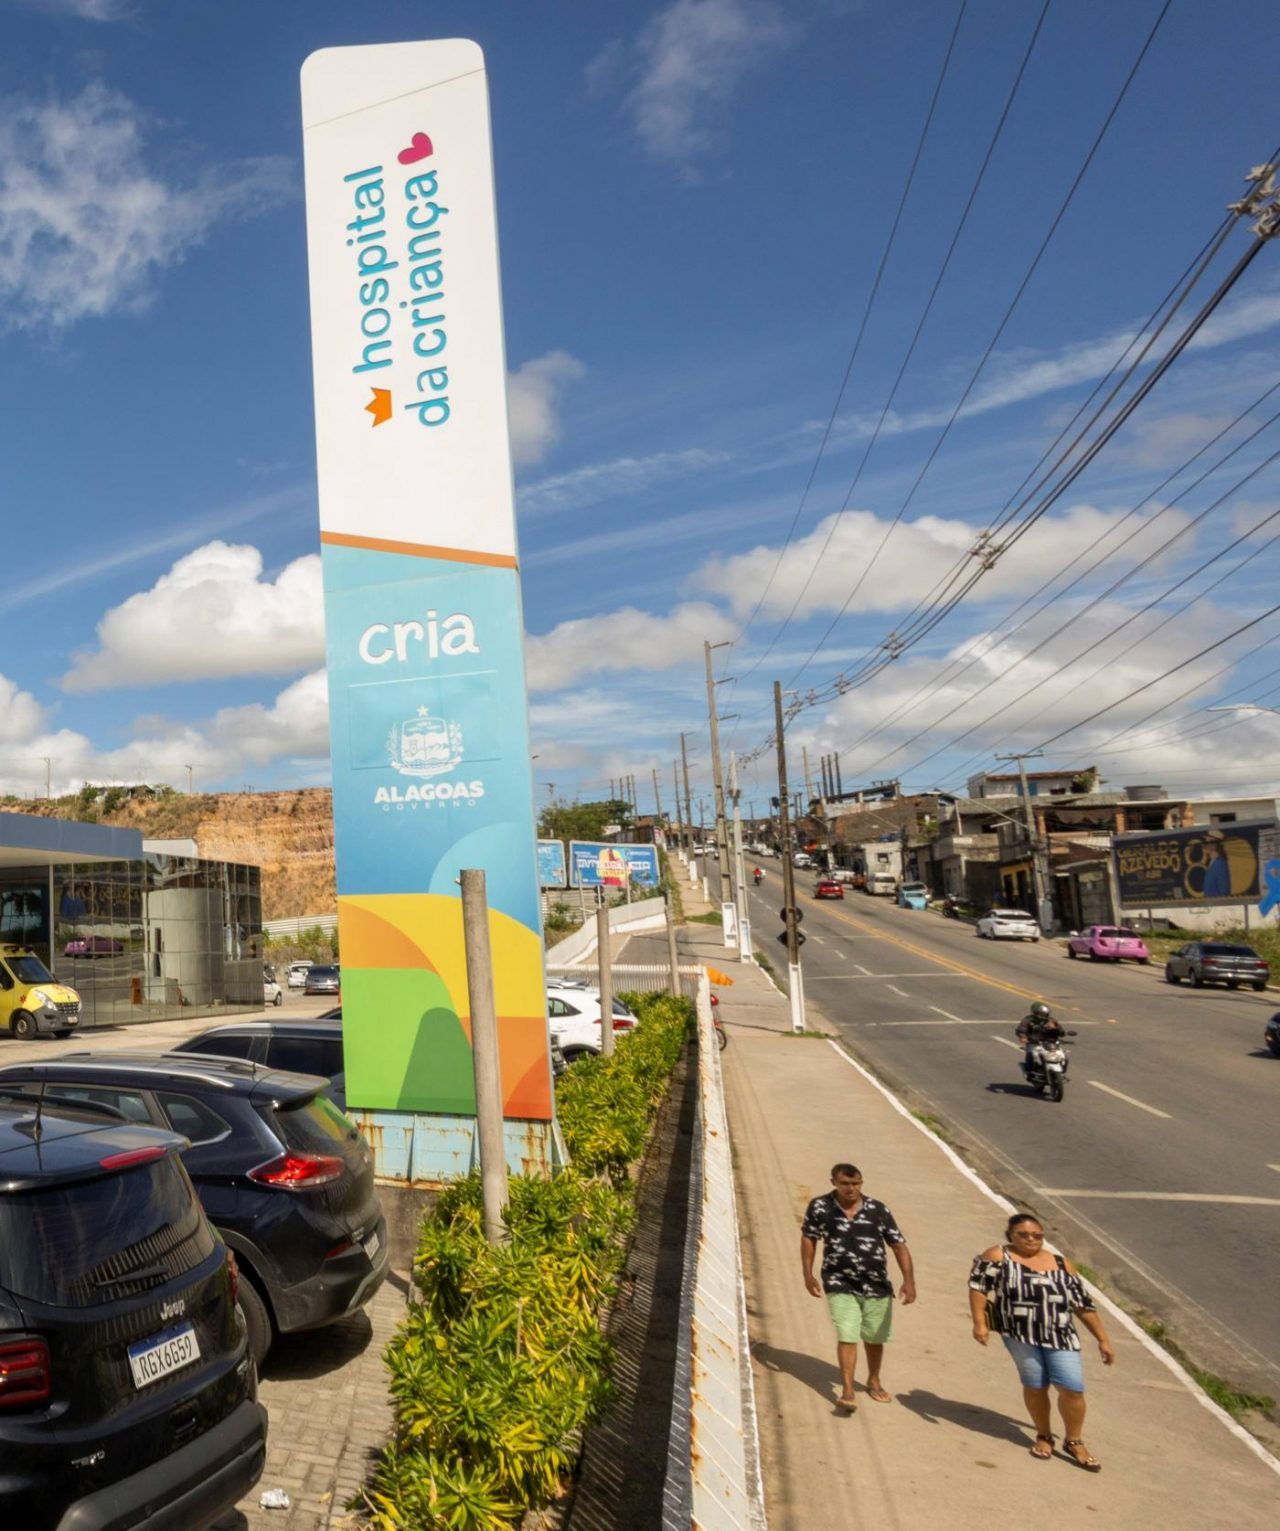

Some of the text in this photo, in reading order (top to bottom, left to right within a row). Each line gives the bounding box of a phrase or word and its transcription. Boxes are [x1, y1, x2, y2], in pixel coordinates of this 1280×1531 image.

[343, 165, 398, 373] hospital
[399, 169, 451, 427] da criança
[358, 608, 480, 665] cria
[374, 781, 484, 803] ALAGOAS
[382, 799, 477, 812] GOVERNO
[160, 1299, 185, 1320] Jeep
[138, 1335, 192, 1380] RGX6G59
